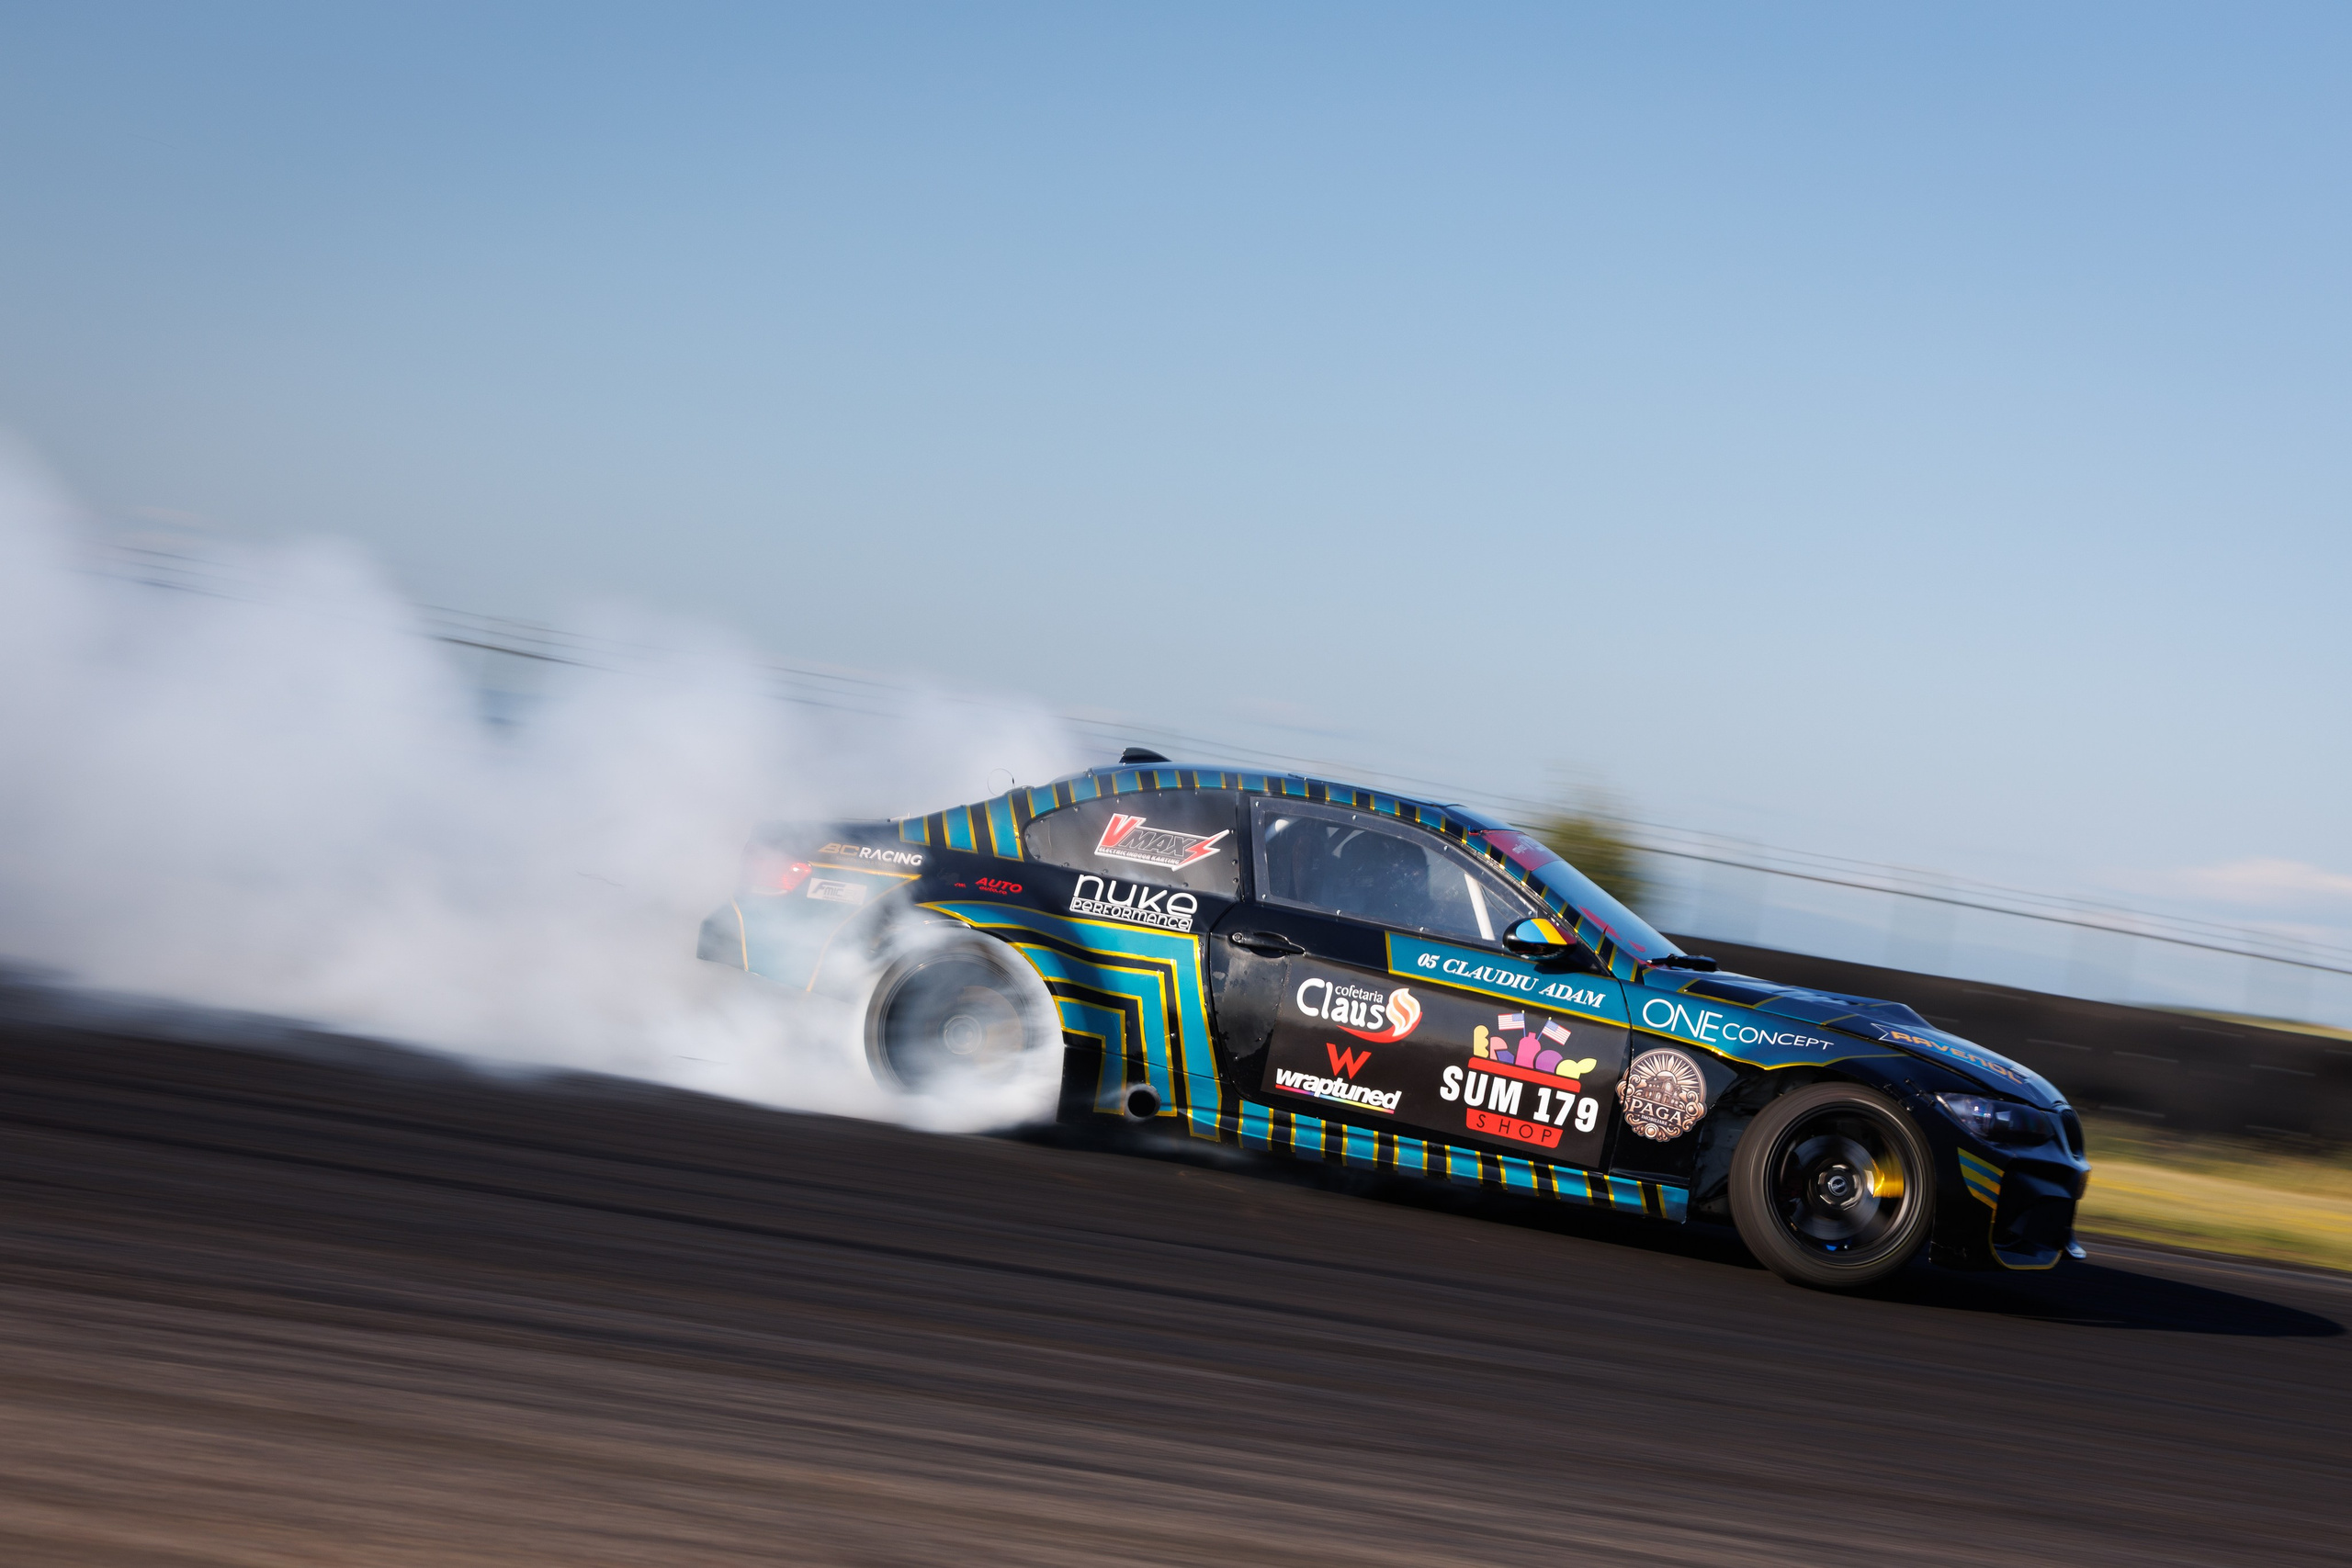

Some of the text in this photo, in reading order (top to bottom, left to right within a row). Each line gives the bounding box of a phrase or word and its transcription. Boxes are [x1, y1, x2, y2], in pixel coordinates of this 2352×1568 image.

[818, 842, 860, 856] BC
[858, 847, 923, 866] RACING
[1101, 814, 1197, 857] VMAX
[975, 877, 1023, 893] AUTO
[1335, 985, 1384, 1004] cofetaria
[1417, 953, 1606, 1009] 05 CLAUDIU ADAM
[1296, 977, 1385, 1030] Claus
[1642, 998, 1835, 1050] ONE CONCEPT
[1275, 1067, 1403, 1111] wraptuned
[1439, 1065, 1600, 1133] SUM 179
[1628, 1098, 1682, 1126] PAGA
